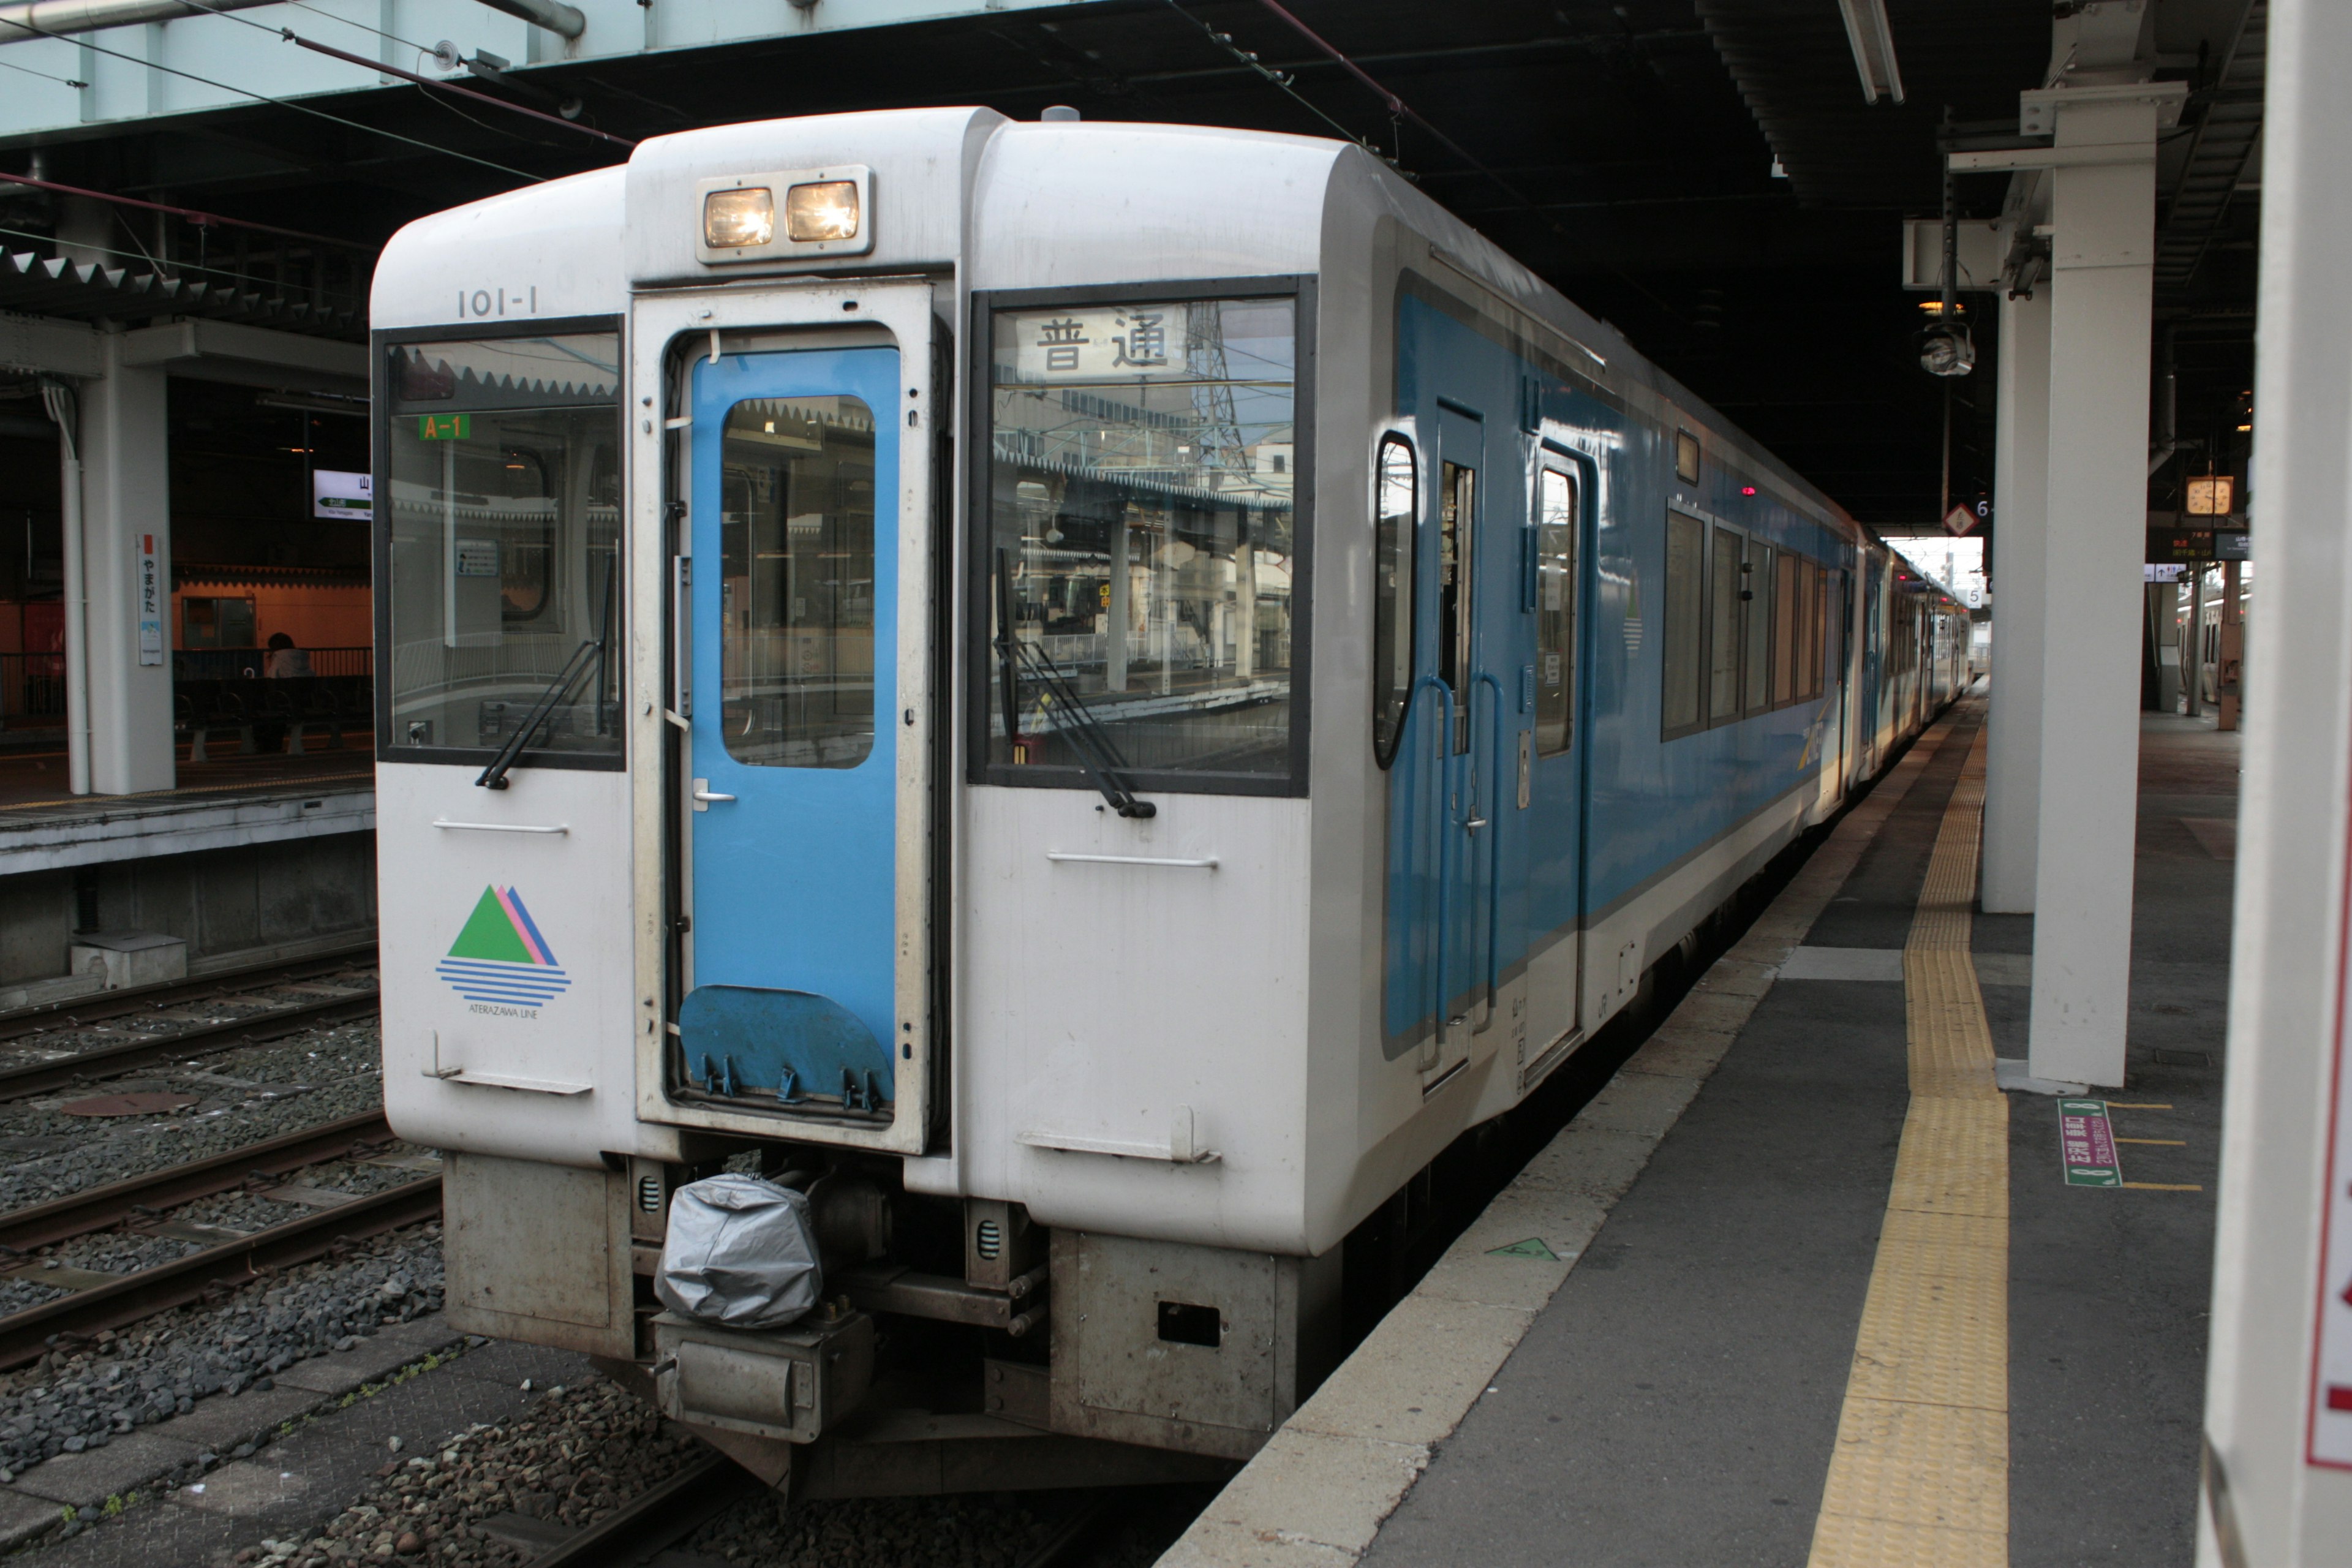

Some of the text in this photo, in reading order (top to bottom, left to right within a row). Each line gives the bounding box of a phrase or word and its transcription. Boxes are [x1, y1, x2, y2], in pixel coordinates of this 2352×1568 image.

[459, 285, 537, 318] 101-1
[1037, 314, 1167, 371] 普通
[424, 416, 461, 438] A-1
[1977, 501, 1988, 516] 6
[144, 559, 156, 613] やまがた
[1970, 590, 1979, 602] 5
[469, 1004, 538, 1019] ATERAZAWA LINE
[2065, 1117, 2088, 1137] 乗車口
